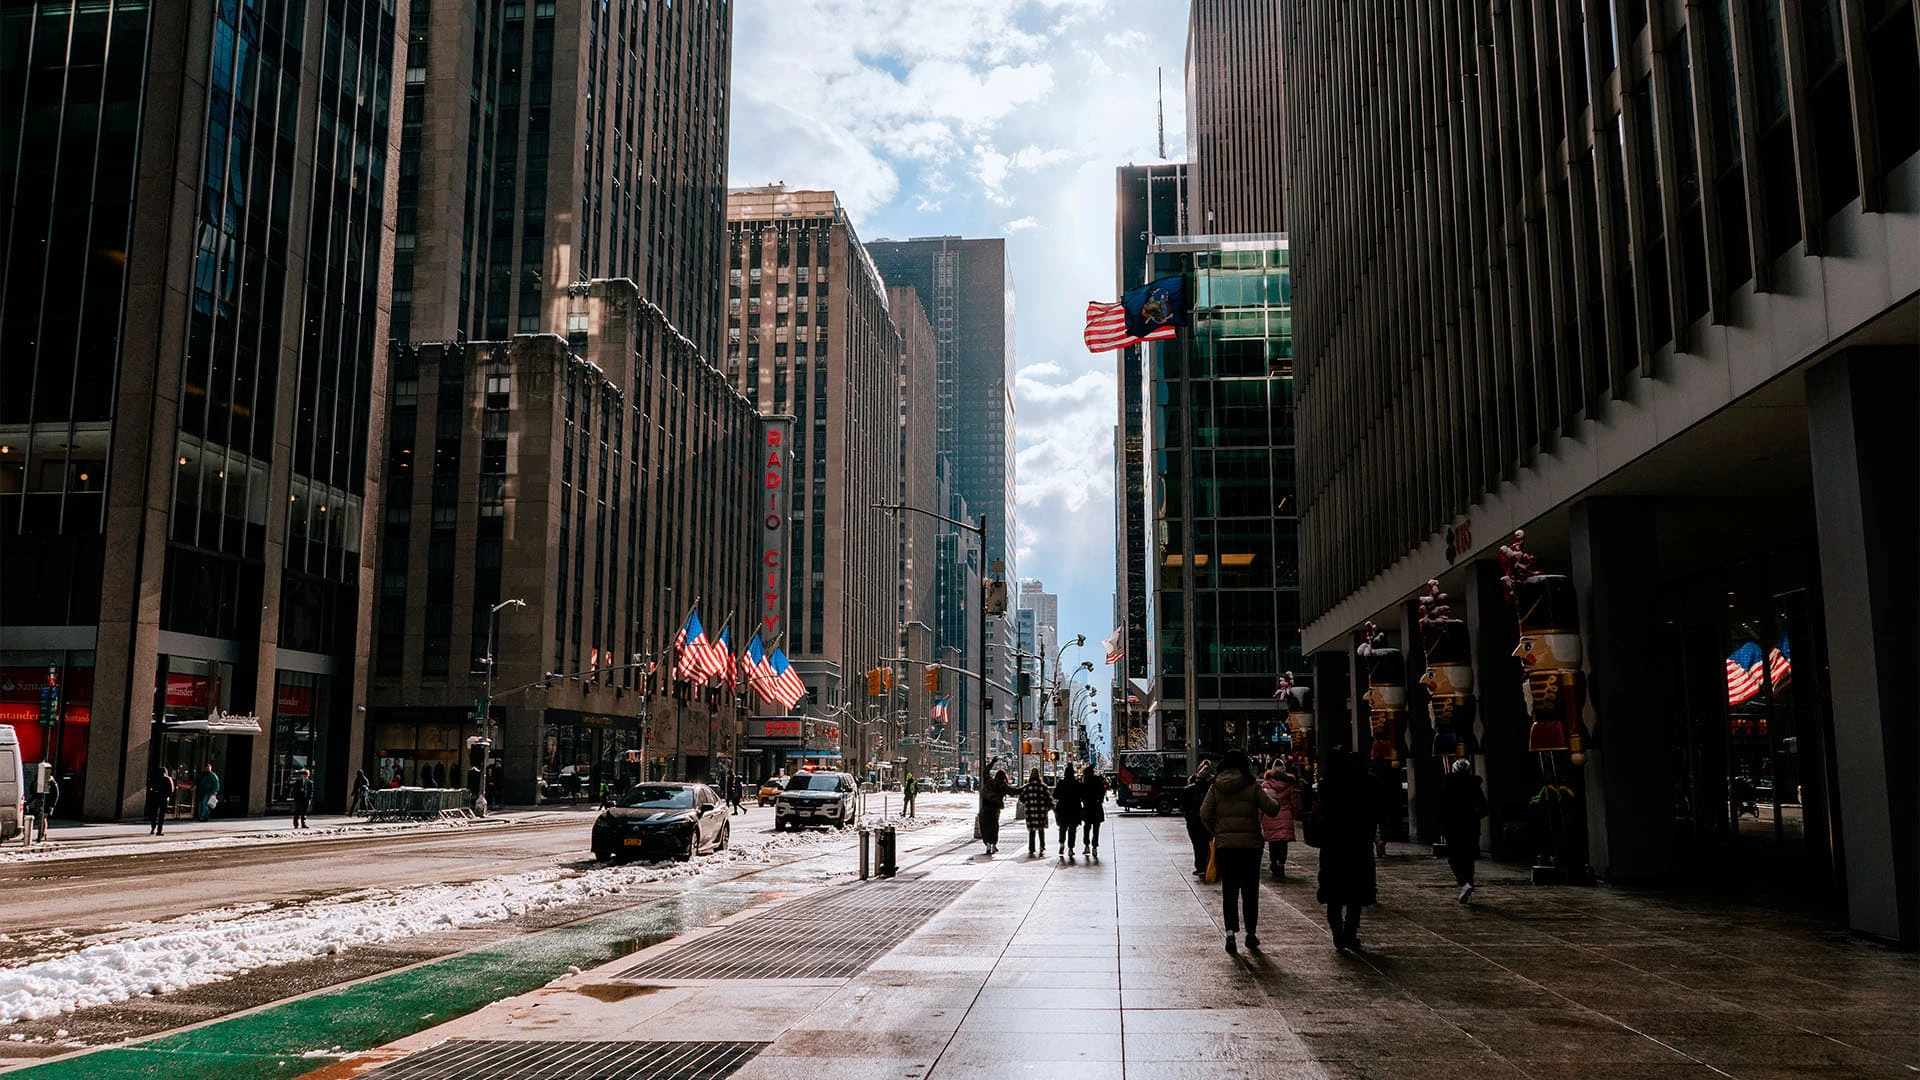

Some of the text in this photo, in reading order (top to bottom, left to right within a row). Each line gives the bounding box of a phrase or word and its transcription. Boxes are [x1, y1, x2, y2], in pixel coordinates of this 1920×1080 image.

[763, 431, 782, 632] RADIO CITY
[221, 711, 260, 724] Santander
